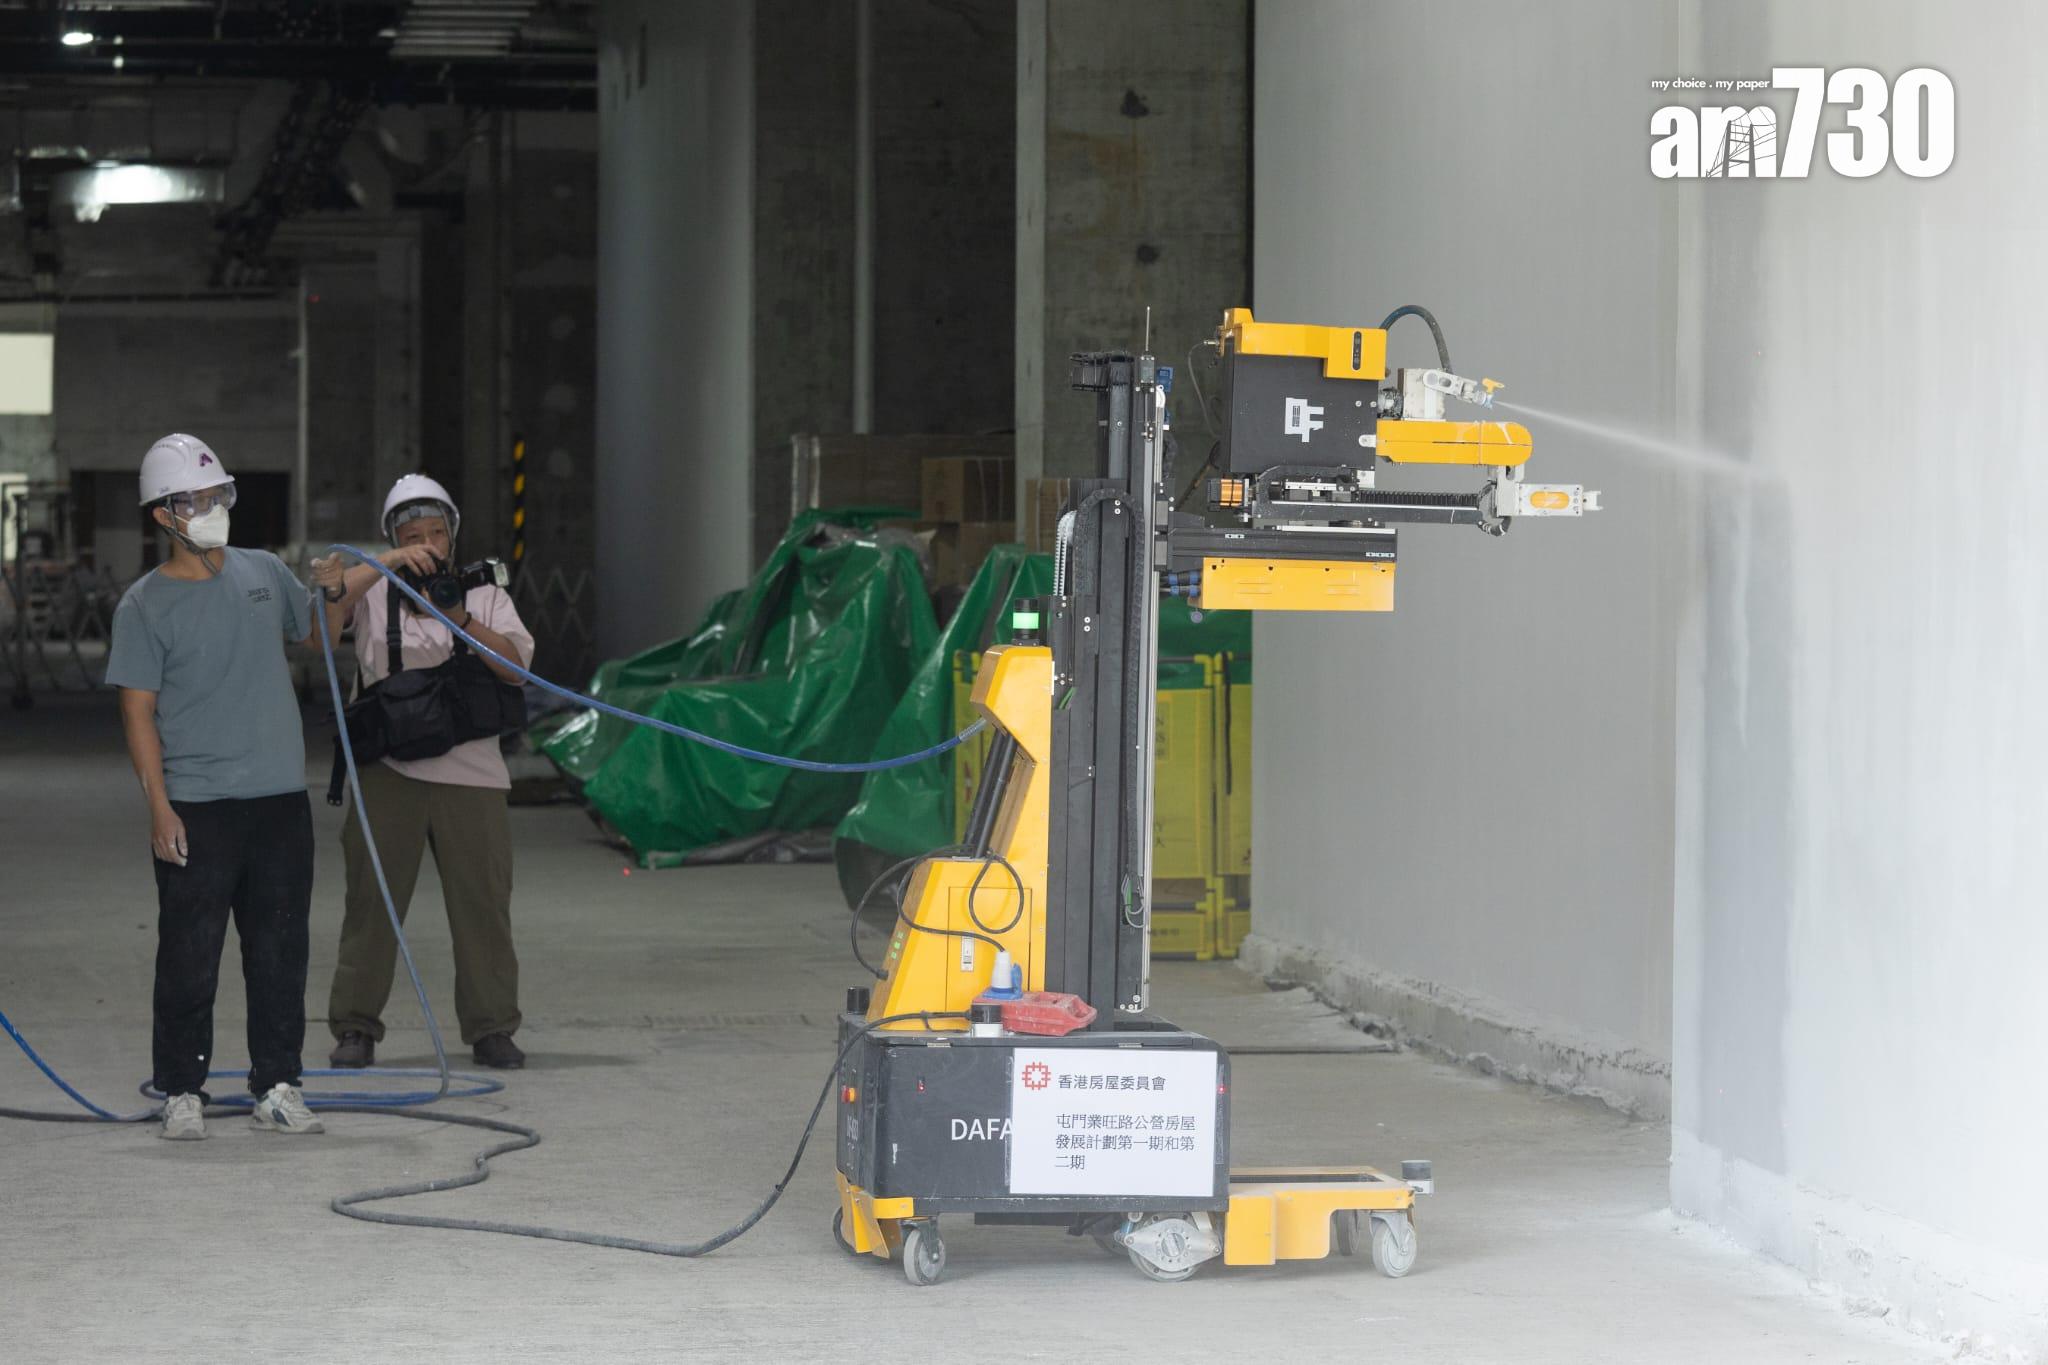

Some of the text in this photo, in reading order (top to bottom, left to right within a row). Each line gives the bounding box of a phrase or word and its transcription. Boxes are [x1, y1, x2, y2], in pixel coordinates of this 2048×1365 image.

[1058, 1074, 1167, 1091] 香港房屋委員會
[1056, 1113, 1196, 1131] 屯門業旺路公營房屋
[1055, 1134, 1195, 1151] 發展計劃第一期和第
[1055, 1154, 1086, 1170] 二期
